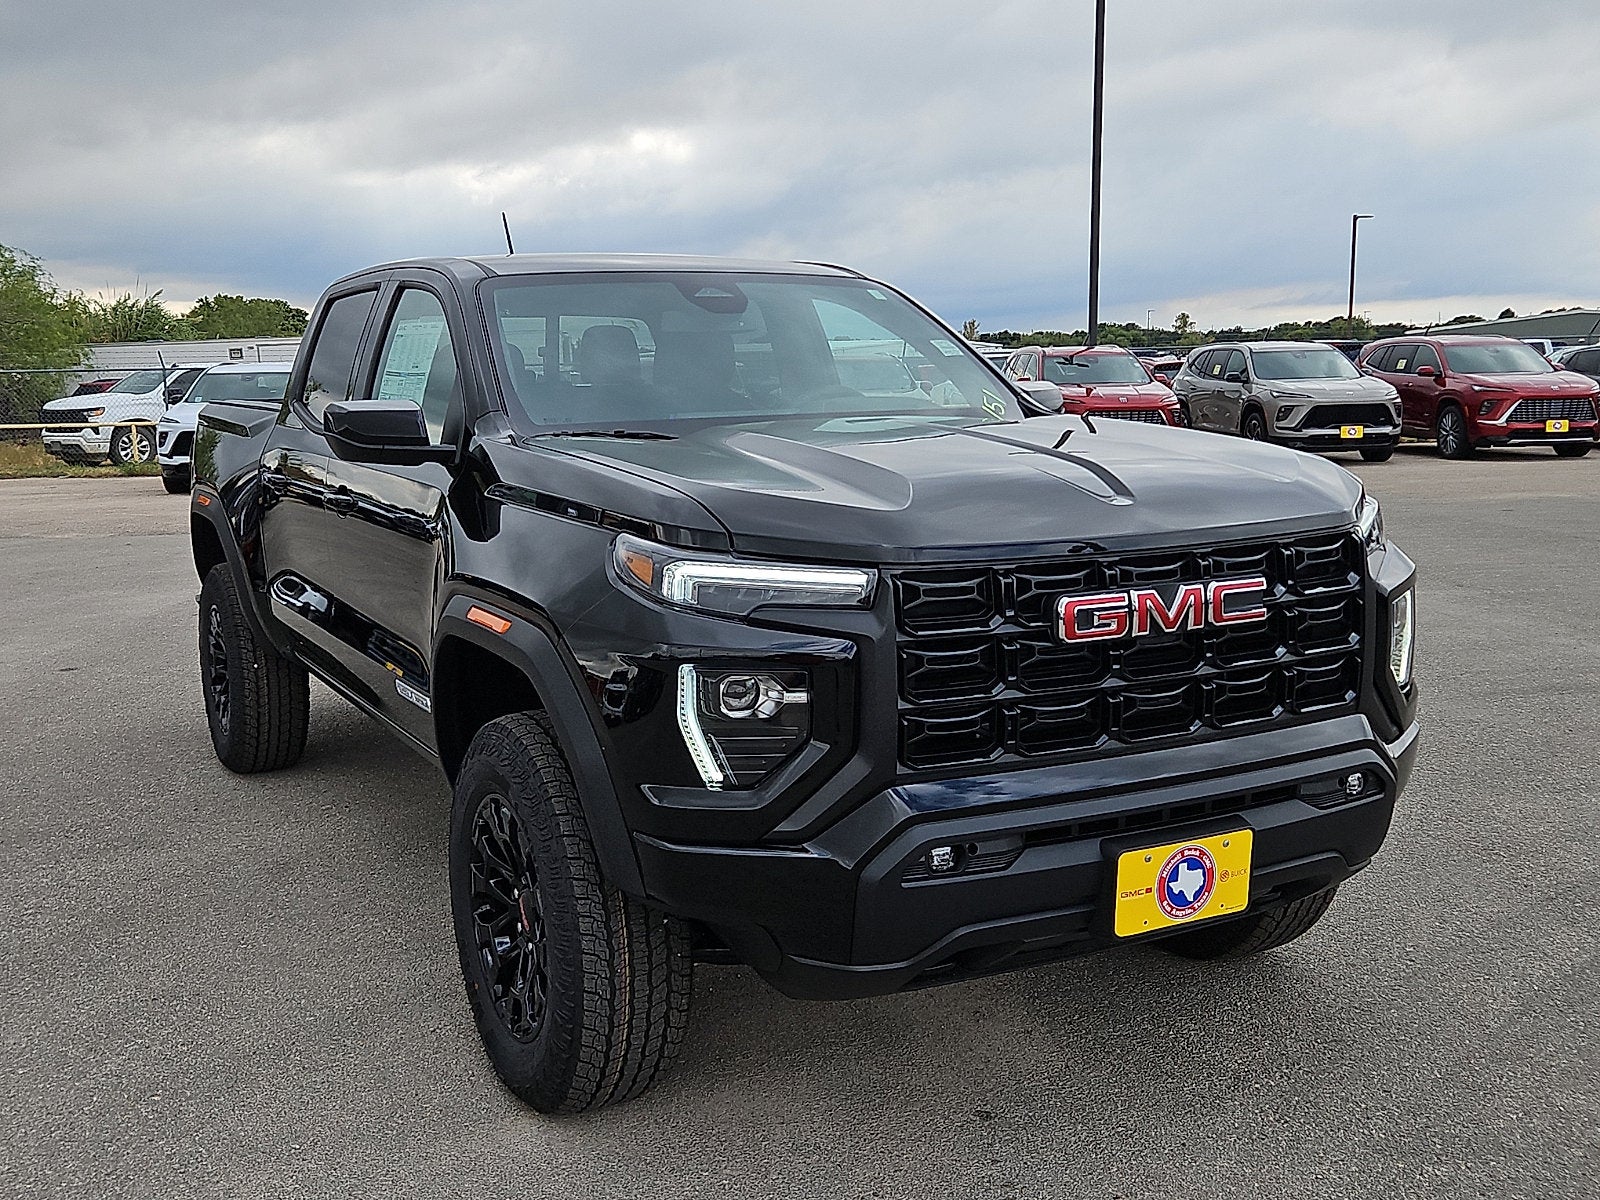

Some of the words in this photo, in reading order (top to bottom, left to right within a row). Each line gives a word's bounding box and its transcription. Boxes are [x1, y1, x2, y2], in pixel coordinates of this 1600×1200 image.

[1058, 577, 1267, 643] GMC
[1162, 853, 1182, 878] Mitchell
[1231, 868, 1247, 878] BUICK
[1120, 888, 1144, 899] GMC
[1162, 900, 1171, 912] San
[1193, 892, 1208, 909] Texas
